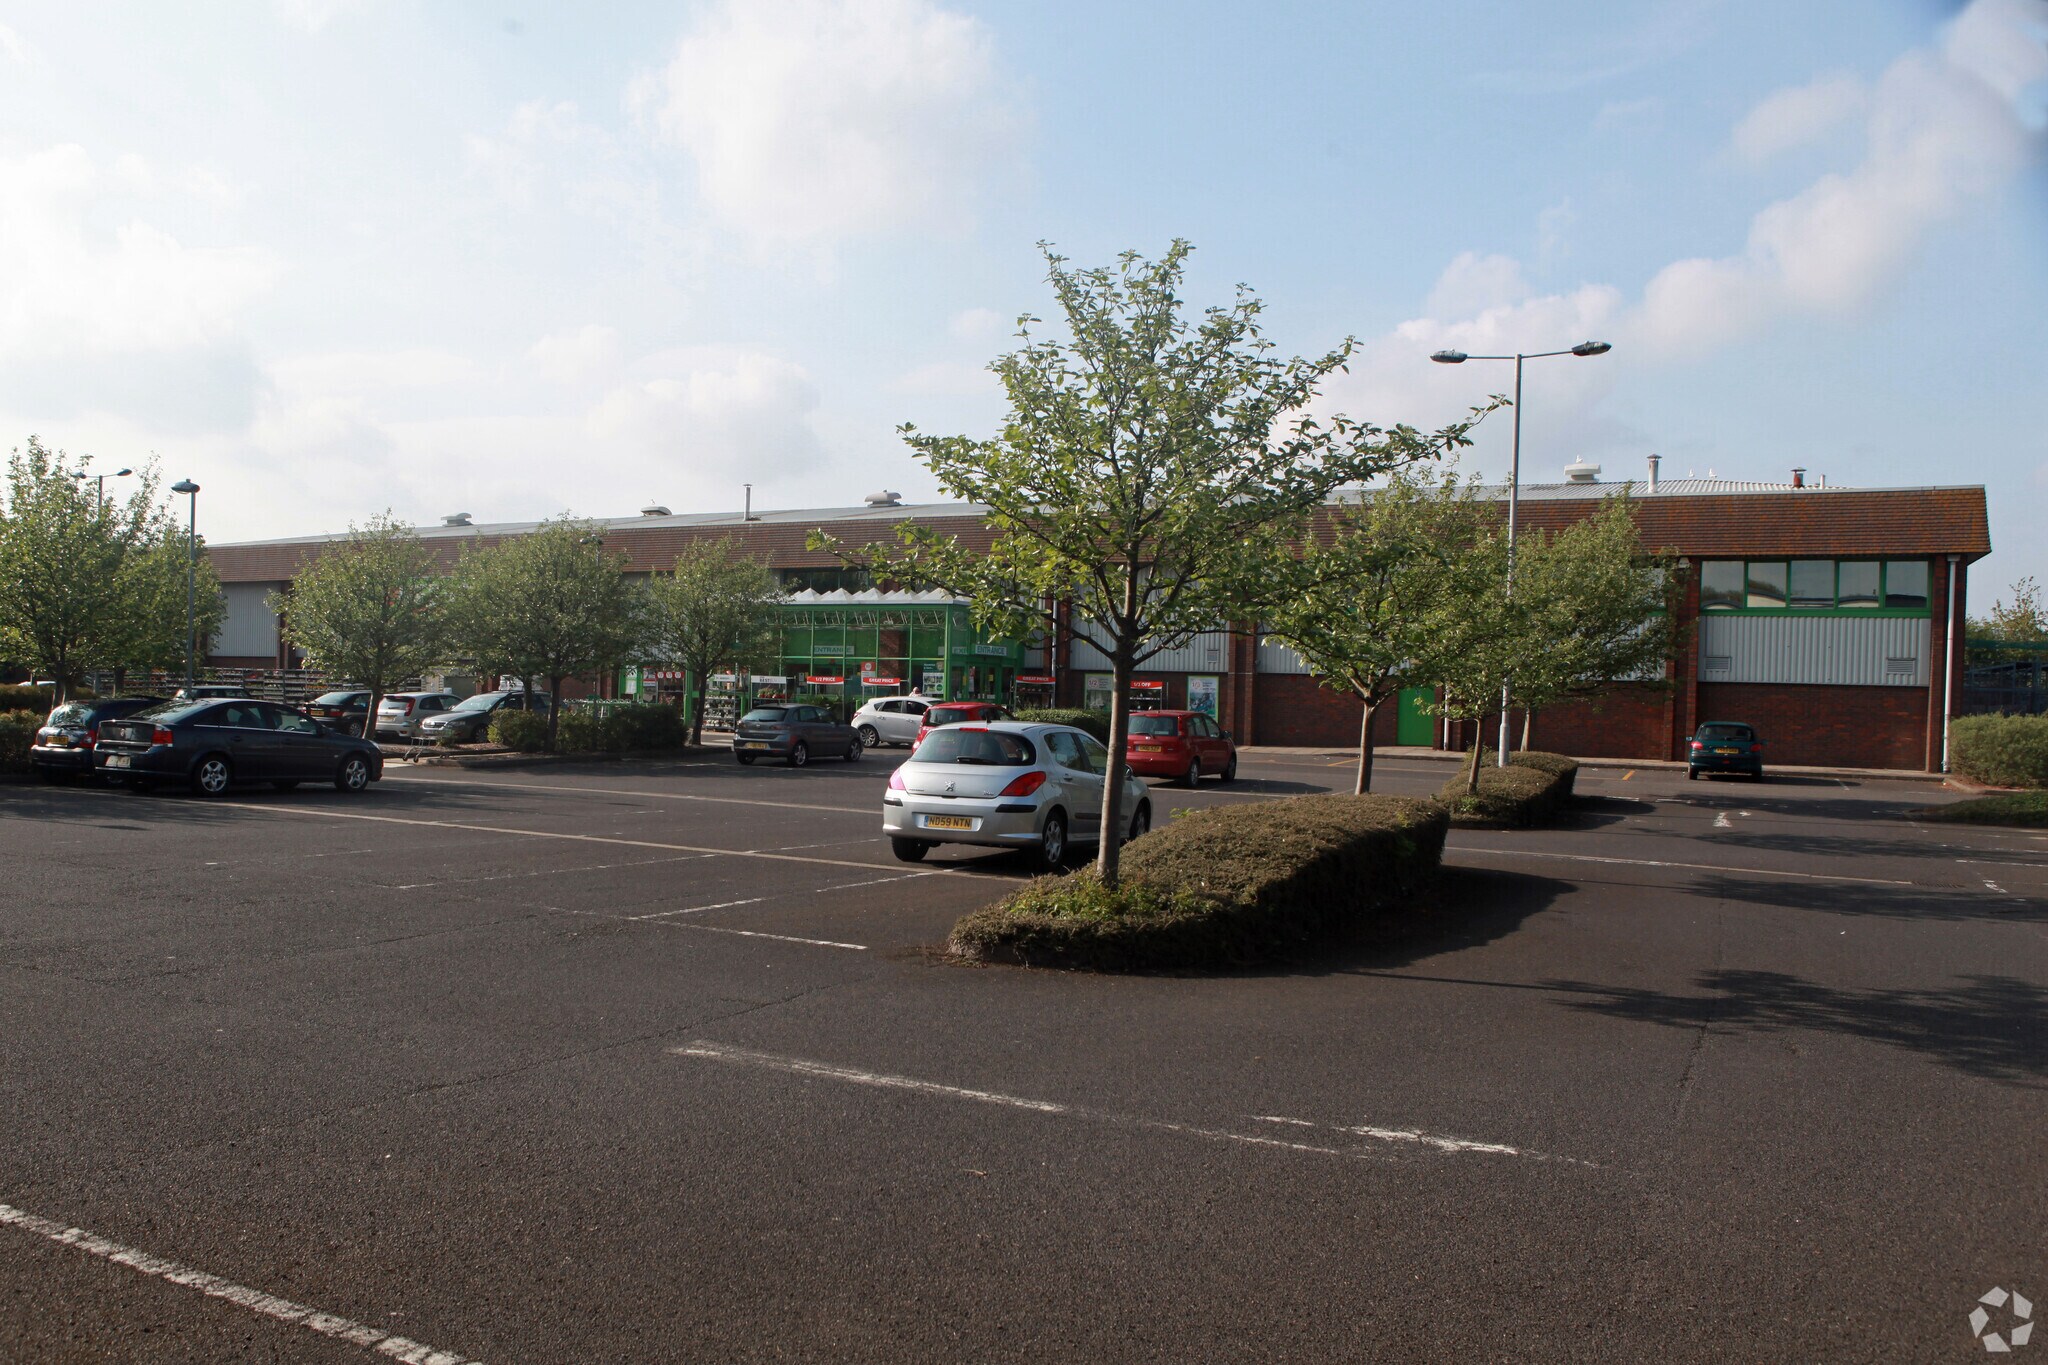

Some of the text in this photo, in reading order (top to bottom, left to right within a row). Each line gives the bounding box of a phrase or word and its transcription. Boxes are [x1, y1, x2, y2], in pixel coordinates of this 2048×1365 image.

[977, 645, 1005, 655] ENTRANCE
[929, 816, 971, 827] ND59 NTN
